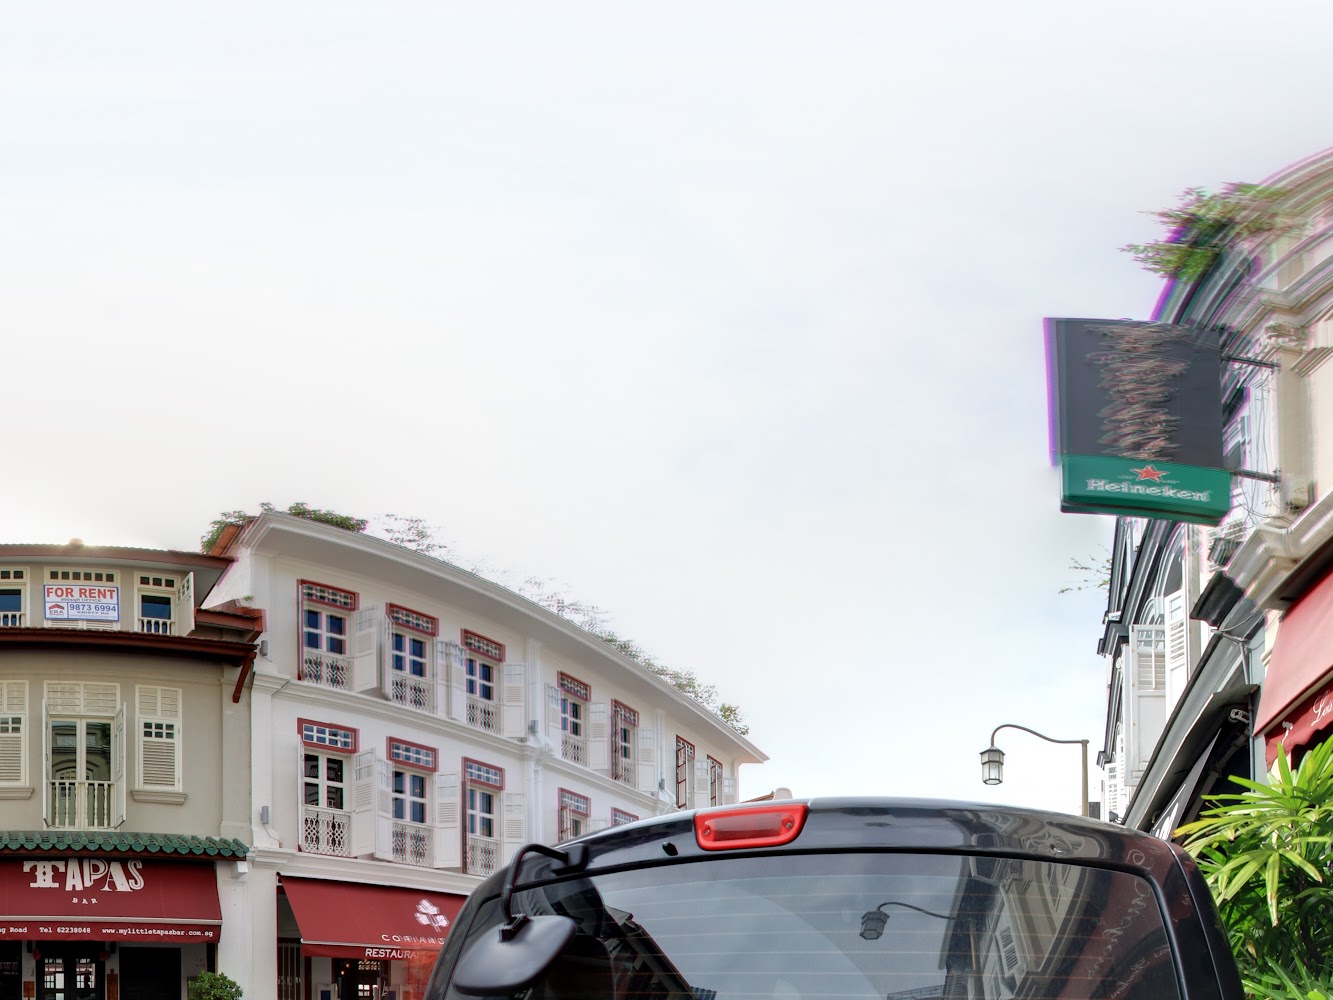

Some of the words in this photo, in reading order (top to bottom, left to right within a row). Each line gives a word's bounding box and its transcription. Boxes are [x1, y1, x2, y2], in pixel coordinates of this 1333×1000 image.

[1087, 479, 1212, 502] Heineken
[46, 587, 74, 598] FOR
[79, 588, 115, 599] RENT
[70, 603, 92, 611] 9873
[23, 858, 144, 892] TAPAS
[102, 927, 213, 938] www.mylittletapasbar.com.sg
